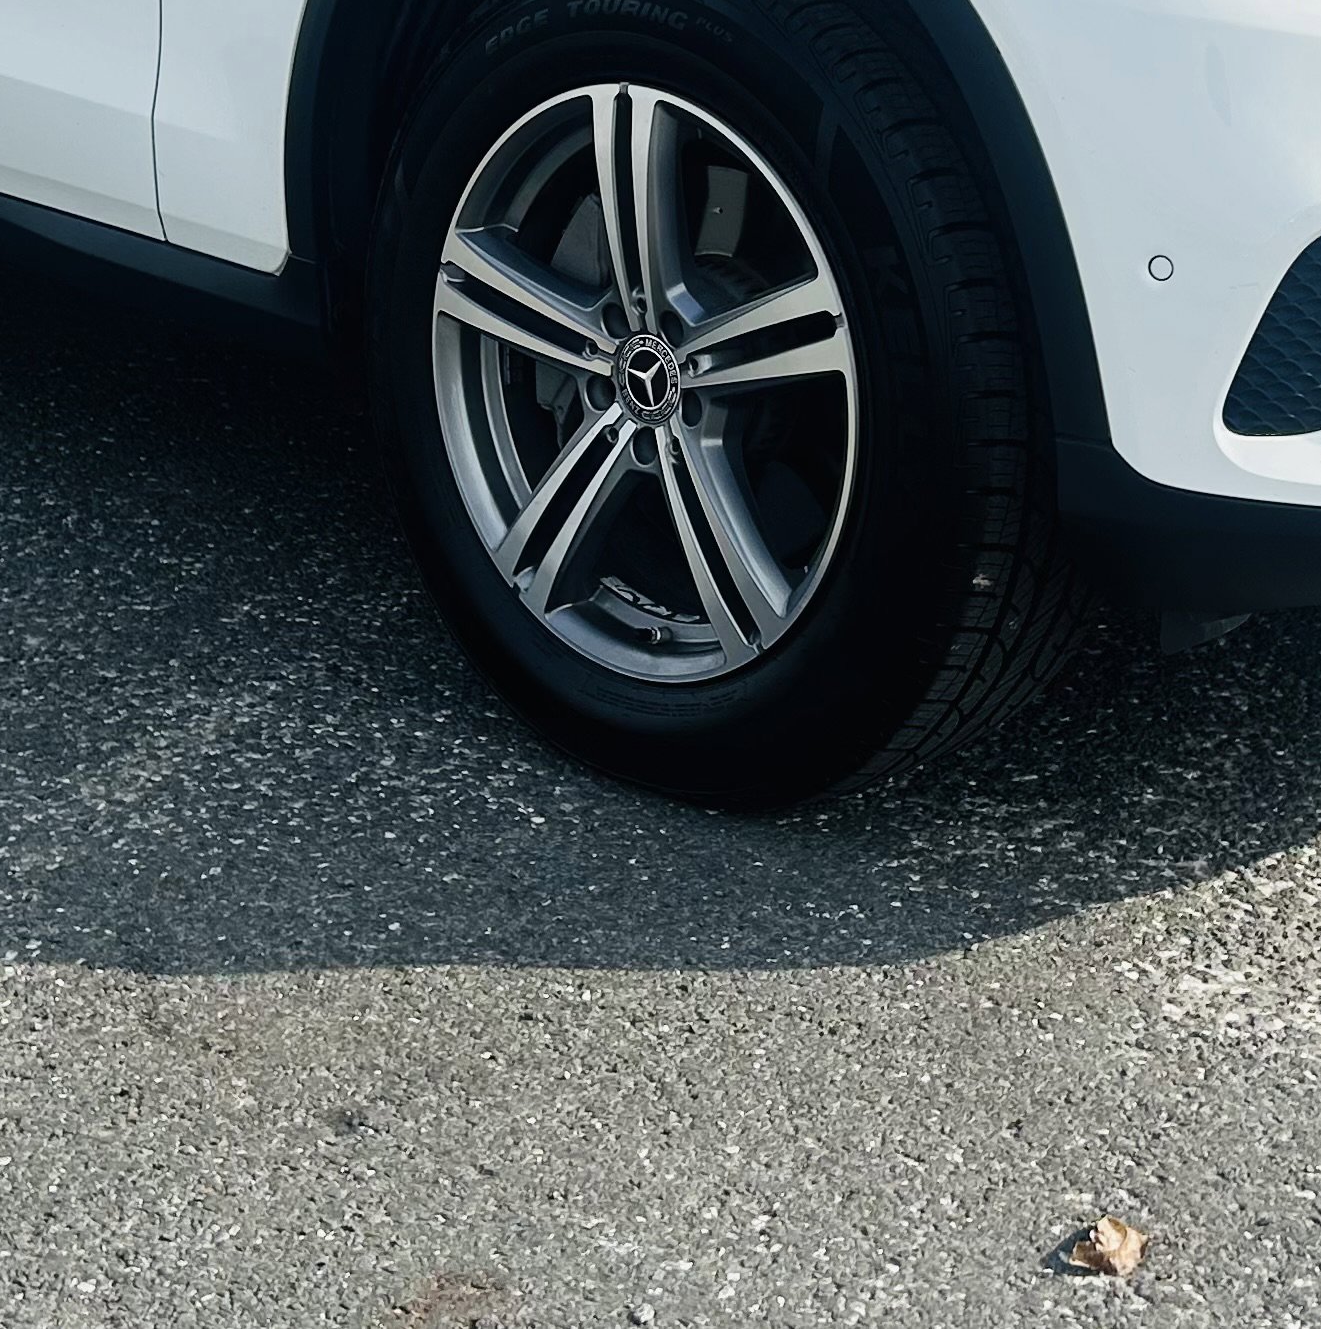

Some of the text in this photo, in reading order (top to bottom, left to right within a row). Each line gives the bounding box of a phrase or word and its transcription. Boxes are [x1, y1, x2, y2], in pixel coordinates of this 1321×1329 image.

[484, 7, 550, 54] EDGE
[695, 16, 735, 43] PLUS
[645, 338, 678, 384] MERCEDES
